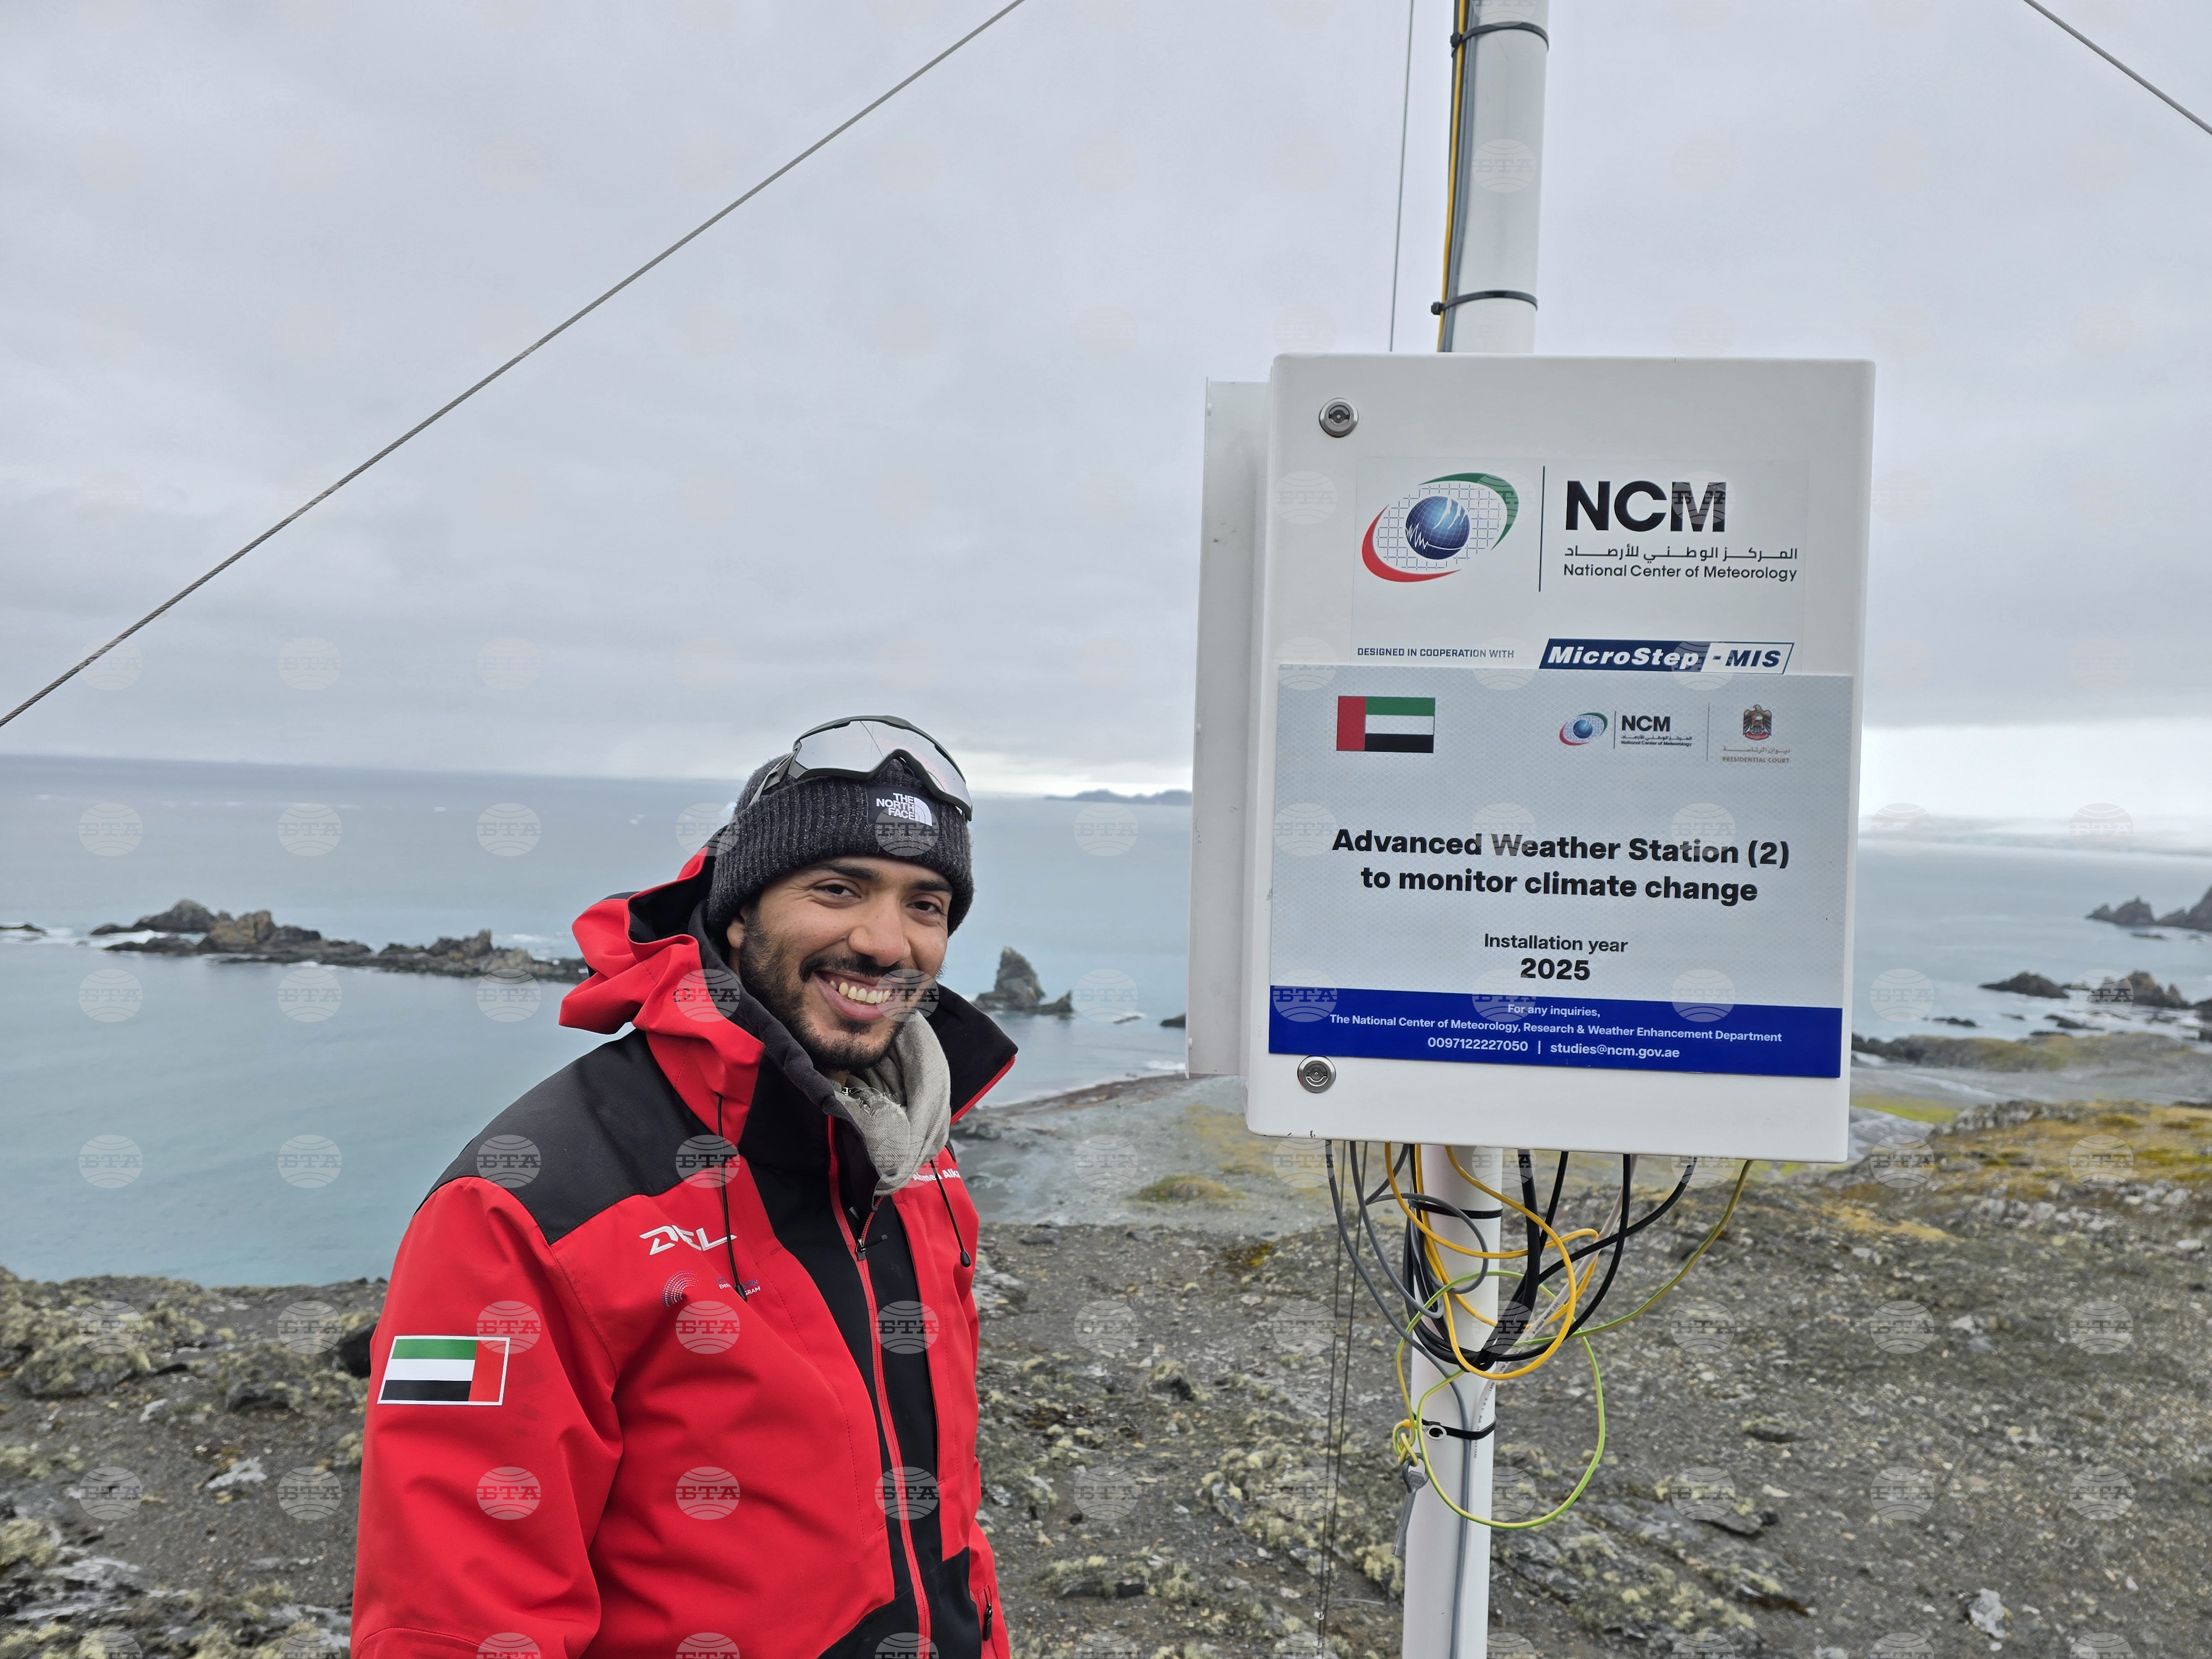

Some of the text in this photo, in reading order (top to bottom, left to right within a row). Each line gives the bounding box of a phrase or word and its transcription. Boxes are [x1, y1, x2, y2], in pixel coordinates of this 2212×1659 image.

[1566, 481, 1726, 533] NCM
[1564, 544, 1797, 564] المركز الوطني للأرصاد
[1564, 564, 1797, 582] National Center of Meteorology
[1358, 648, 1514, 658] DESIGNED IN COOPERATION WITH
[1621, 715, 1671, 732] NCM
[876, 798, 915, 812] NORTH
[893, 792, 914, 804] THE
[888, 807, 915, 821] FACE
[1332, 829, 1789, 869] Advanced Weather Station (2)
[1360, 867, 1757, 907] to monitor climate change
[1484, 933, 1629, 955] Installation year
[1520, 957, 1590, 981] 2025
[1507, 1004, 1600, 1018] For any inquiries,
[1329, 1014, 1782, 1042] The National Center of Meteorology, Research & Weather Enhancement Department
[1427, 1037, 1528, 1051] 0097122227050
[1550, 1043, 1680, 1059] studies@ncm.gov.ae
